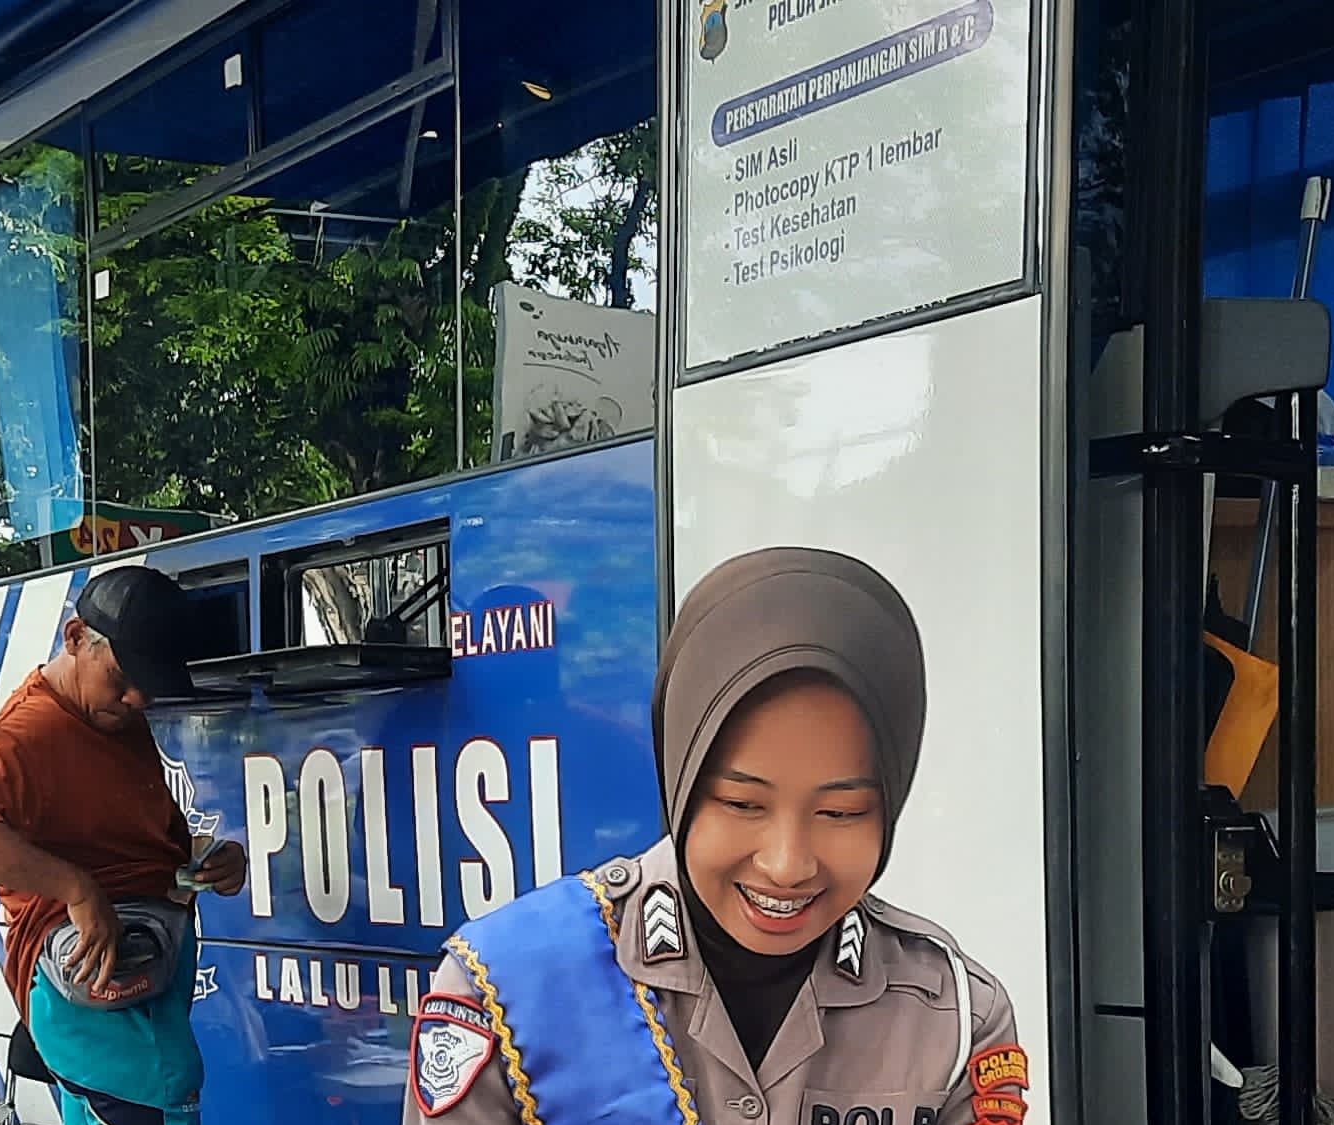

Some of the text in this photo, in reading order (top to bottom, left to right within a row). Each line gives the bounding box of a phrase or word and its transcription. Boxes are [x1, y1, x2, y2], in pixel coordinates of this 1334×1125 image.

[724, 80, 807, 135] PERSYARATAN
[808, 45, 908, 103] PERPANJANGAN
[907, 31, 936, 64] SIM
[937, 23, 949, 53] A
[734, 137, 798, 182] SIM Asli
[734, 127, 943, 216] Photocopy KTP 1 lembar
[733, 195, 857, 250] Test Kesehatan
[733, 227, 846, 285] Test Psikologi
[450, 600, 555, 659] ELAYANI
[243, 737, 564, 928] POLISI
[254, 953, 438, 1018] LALU LI
